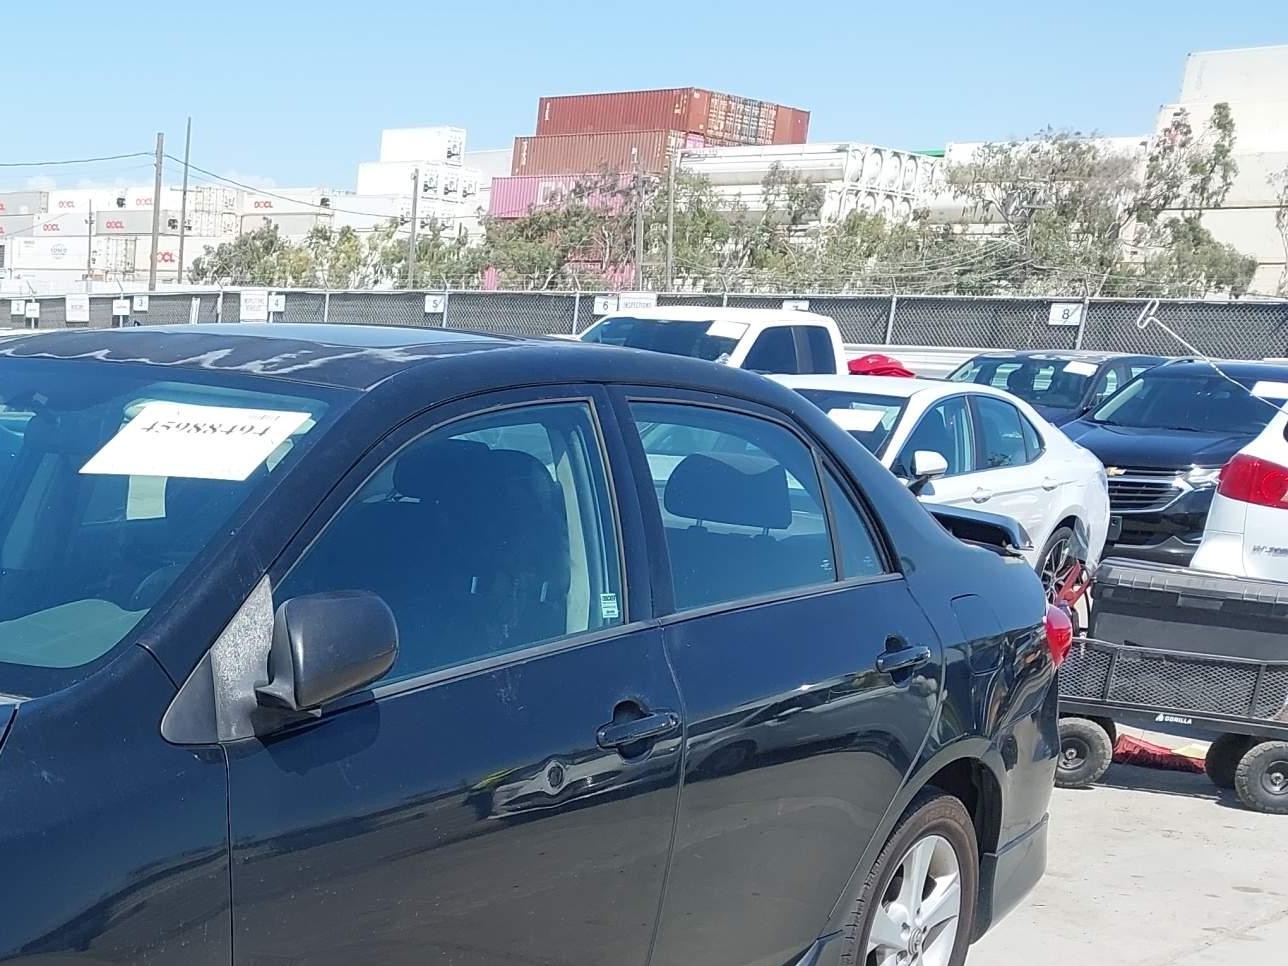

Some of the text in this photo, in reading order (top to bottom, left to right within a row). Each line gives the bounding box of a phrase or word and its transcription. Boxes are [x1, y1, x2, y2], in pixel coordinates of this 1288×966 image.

[156, 251, 175, 263] OCL
[432, 299, 439, 309] 5
[602, 301, 609, 311] 6
[1062, 308, 1070, 320] 8
[1164, 715, 1192, 725] GORILLA
